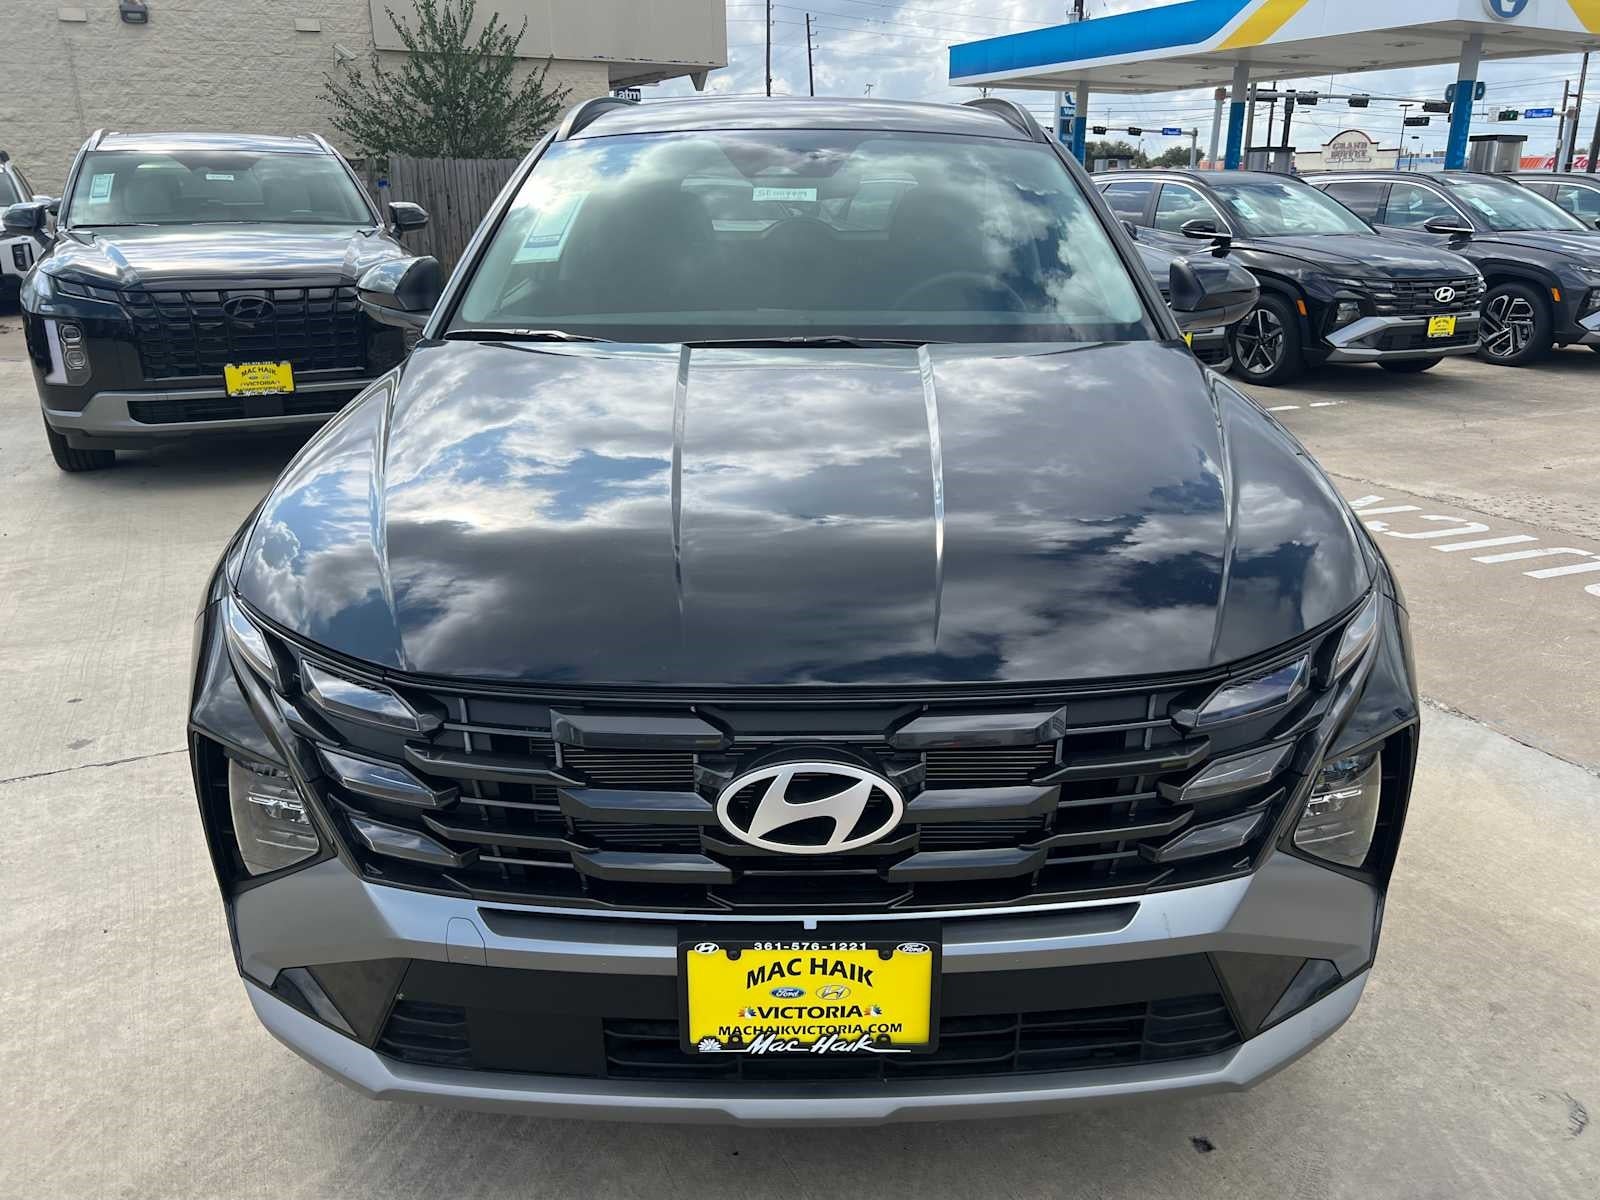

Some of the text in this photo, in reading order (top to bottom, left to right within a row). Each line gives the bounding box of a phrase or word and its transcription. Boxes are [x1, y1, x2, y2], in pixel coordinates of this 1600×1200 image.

[618, 89, 640, 100] atm
[754, 942, 867, 951] 361-576-1221
[746, 957, 875, 989] MAC HAIK
[756, 1005, 865, 1019] VICTORIA
[718, 1023, 903, 1036] MACHAIKVICTORIA.COM
[743, 1033, 875, 1055] Mac Haik
